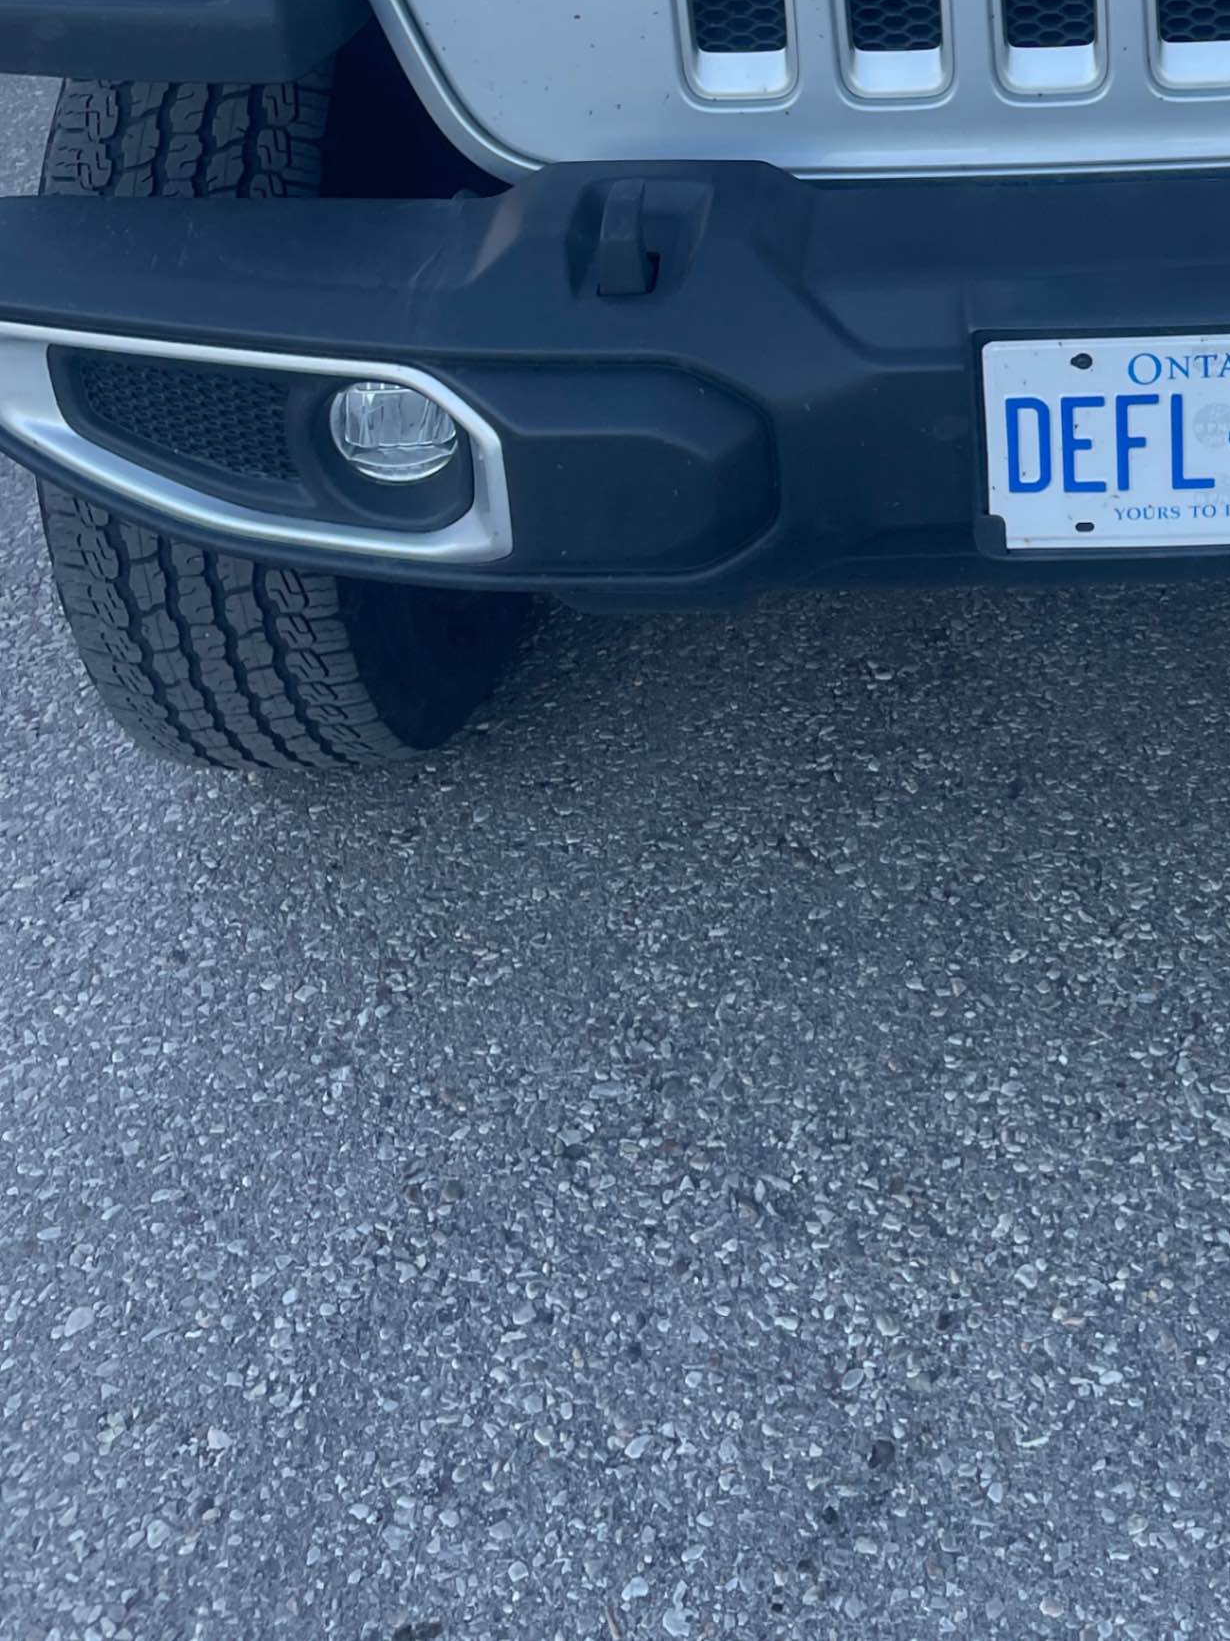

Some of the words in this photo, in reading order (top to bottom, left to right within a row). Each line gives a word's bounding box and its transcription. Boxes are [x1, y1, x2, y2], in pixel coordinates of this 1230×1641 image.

[1004, 393, 1216, 494] DEFL
[1114, 505, 1182, 522] YOURS
[1191, 503, 1217, 519] TO
